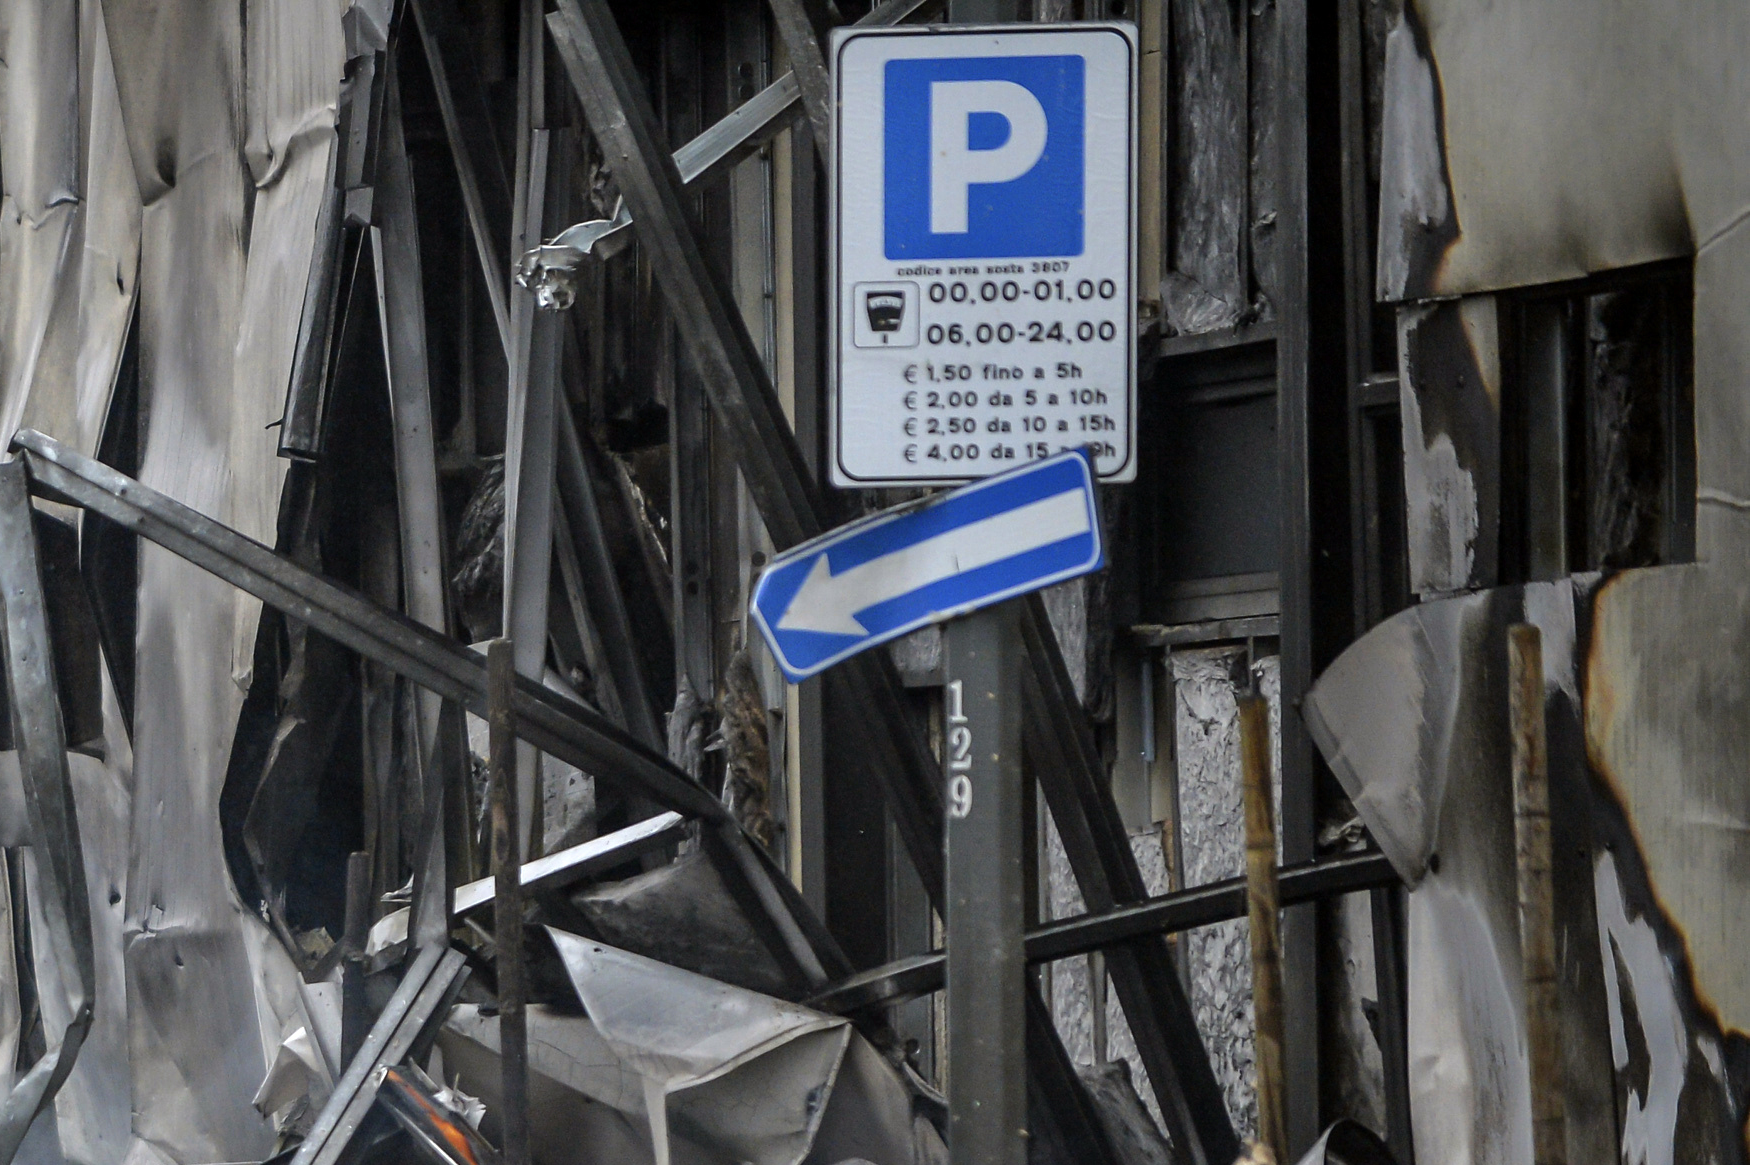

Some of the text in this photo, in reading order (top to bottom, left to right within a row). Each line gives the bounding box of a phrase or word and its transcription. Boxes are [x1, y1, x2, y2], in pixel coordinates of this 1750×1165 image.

[930, 79, 1048, 233] P
[897, 264, 942, 277] codice
[949, 266, 979, 276] area
[986, 263, 1024, 275] sosta
[903, 364, 918, 384] €
[982, 363, 1024, 380] fino
[1034, 366, 1045, 380] a
[1056, 361, 1083, 379] 5h
[903, 391, 918, 410] €
[988, 390, 1013, 407] da
[1025, 389, 1037, 406] 5
[1048, 393, 1059, 405] a
[1070, 388, 1108, 406] 10h
[903, 417, 918, 436] €
[987, 416, 1012, 433] da
[1023, 415, 1047, 432] 10
[1057, 419, 1069, 432] a
[1079, 414, 1116, 432] 15h
[903, 443, 918, 463] €
[990, 442, 1015, 459] da
[1026, 441, 1049, 459] 15
[1088, 440, 1116, 458] 9h
[949, 679, 972, 819] 129
